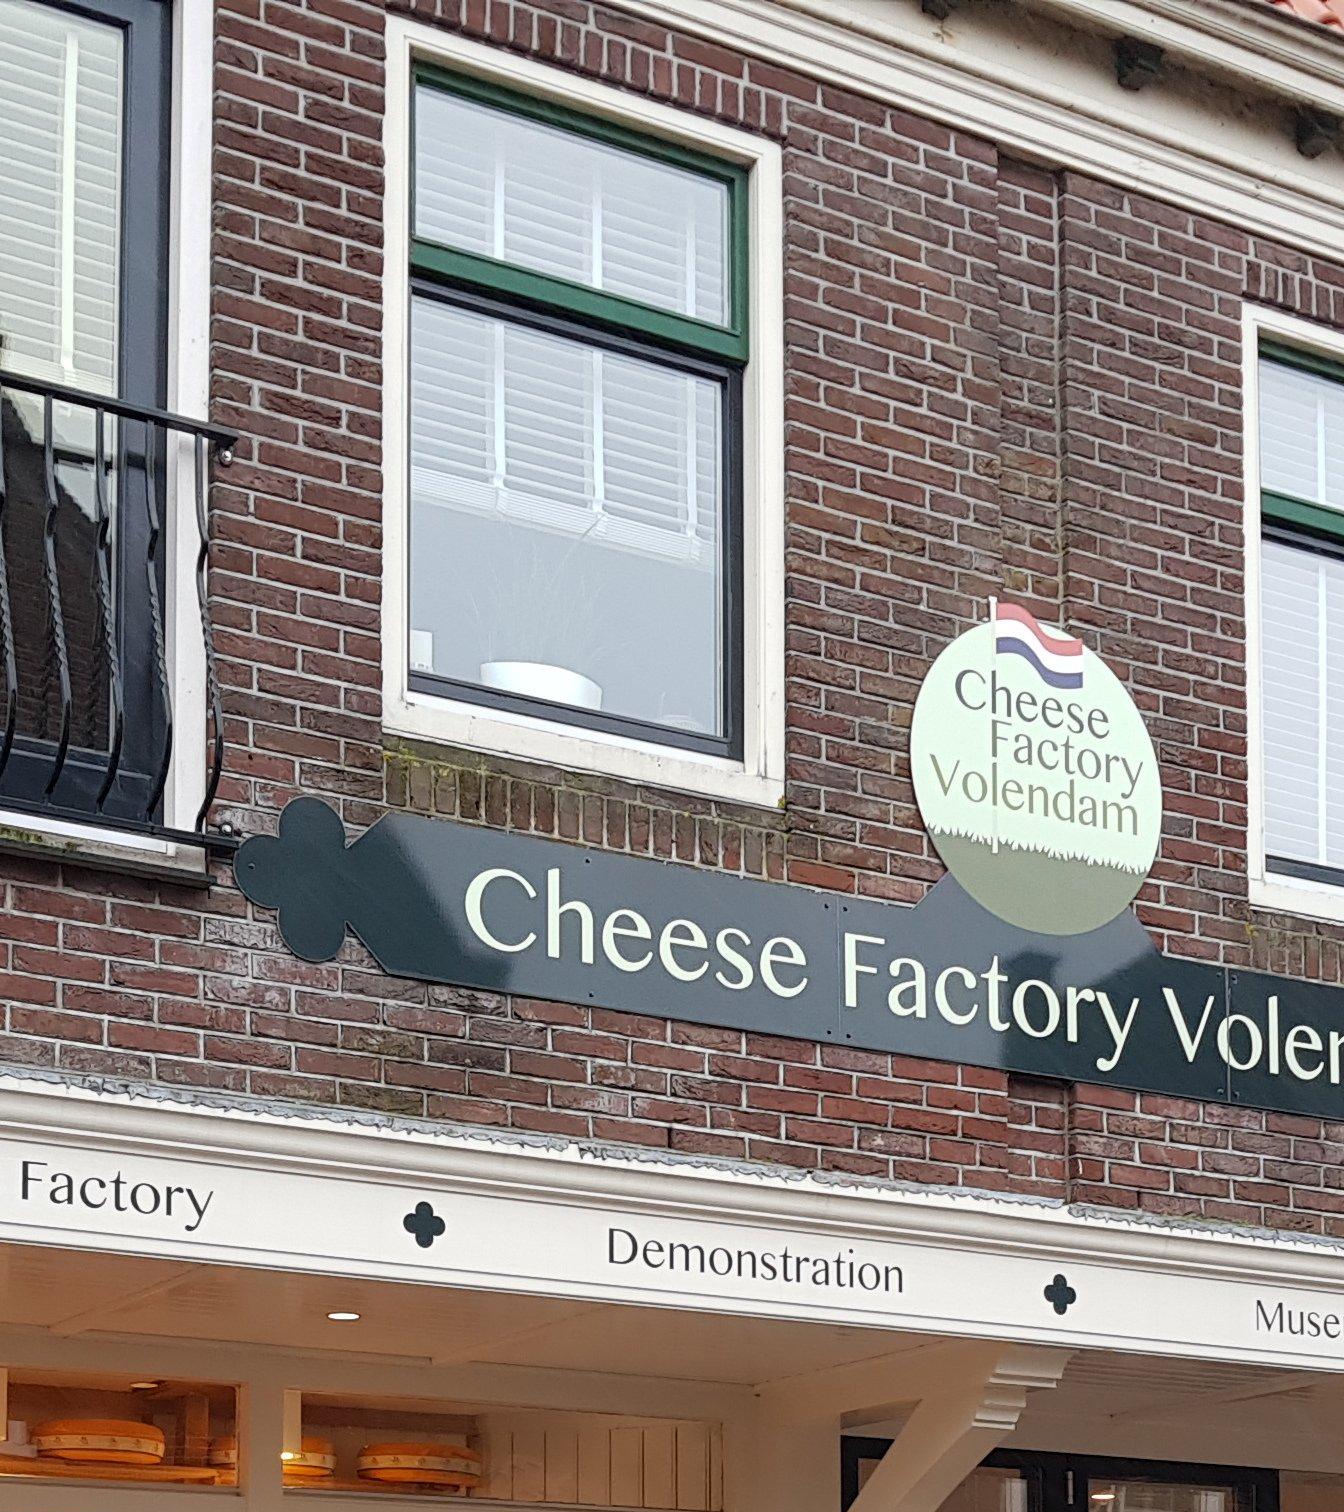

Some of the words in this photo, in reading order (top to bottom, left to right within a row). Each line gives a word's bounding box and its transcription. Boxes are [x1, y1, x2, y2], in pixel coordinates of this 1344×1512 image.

[955, 669, 1110, 740] Cheese
[929, 753, 1139, 836] Volendam
[991, 720, 1144, 799] Factory
[465, 867, 809, 999] Cheese
[843, 932, 1140, 1073] Factory
[19, 1160, 214, 1231] Factory
[607, 1227, 904, 1293] Demonstration
